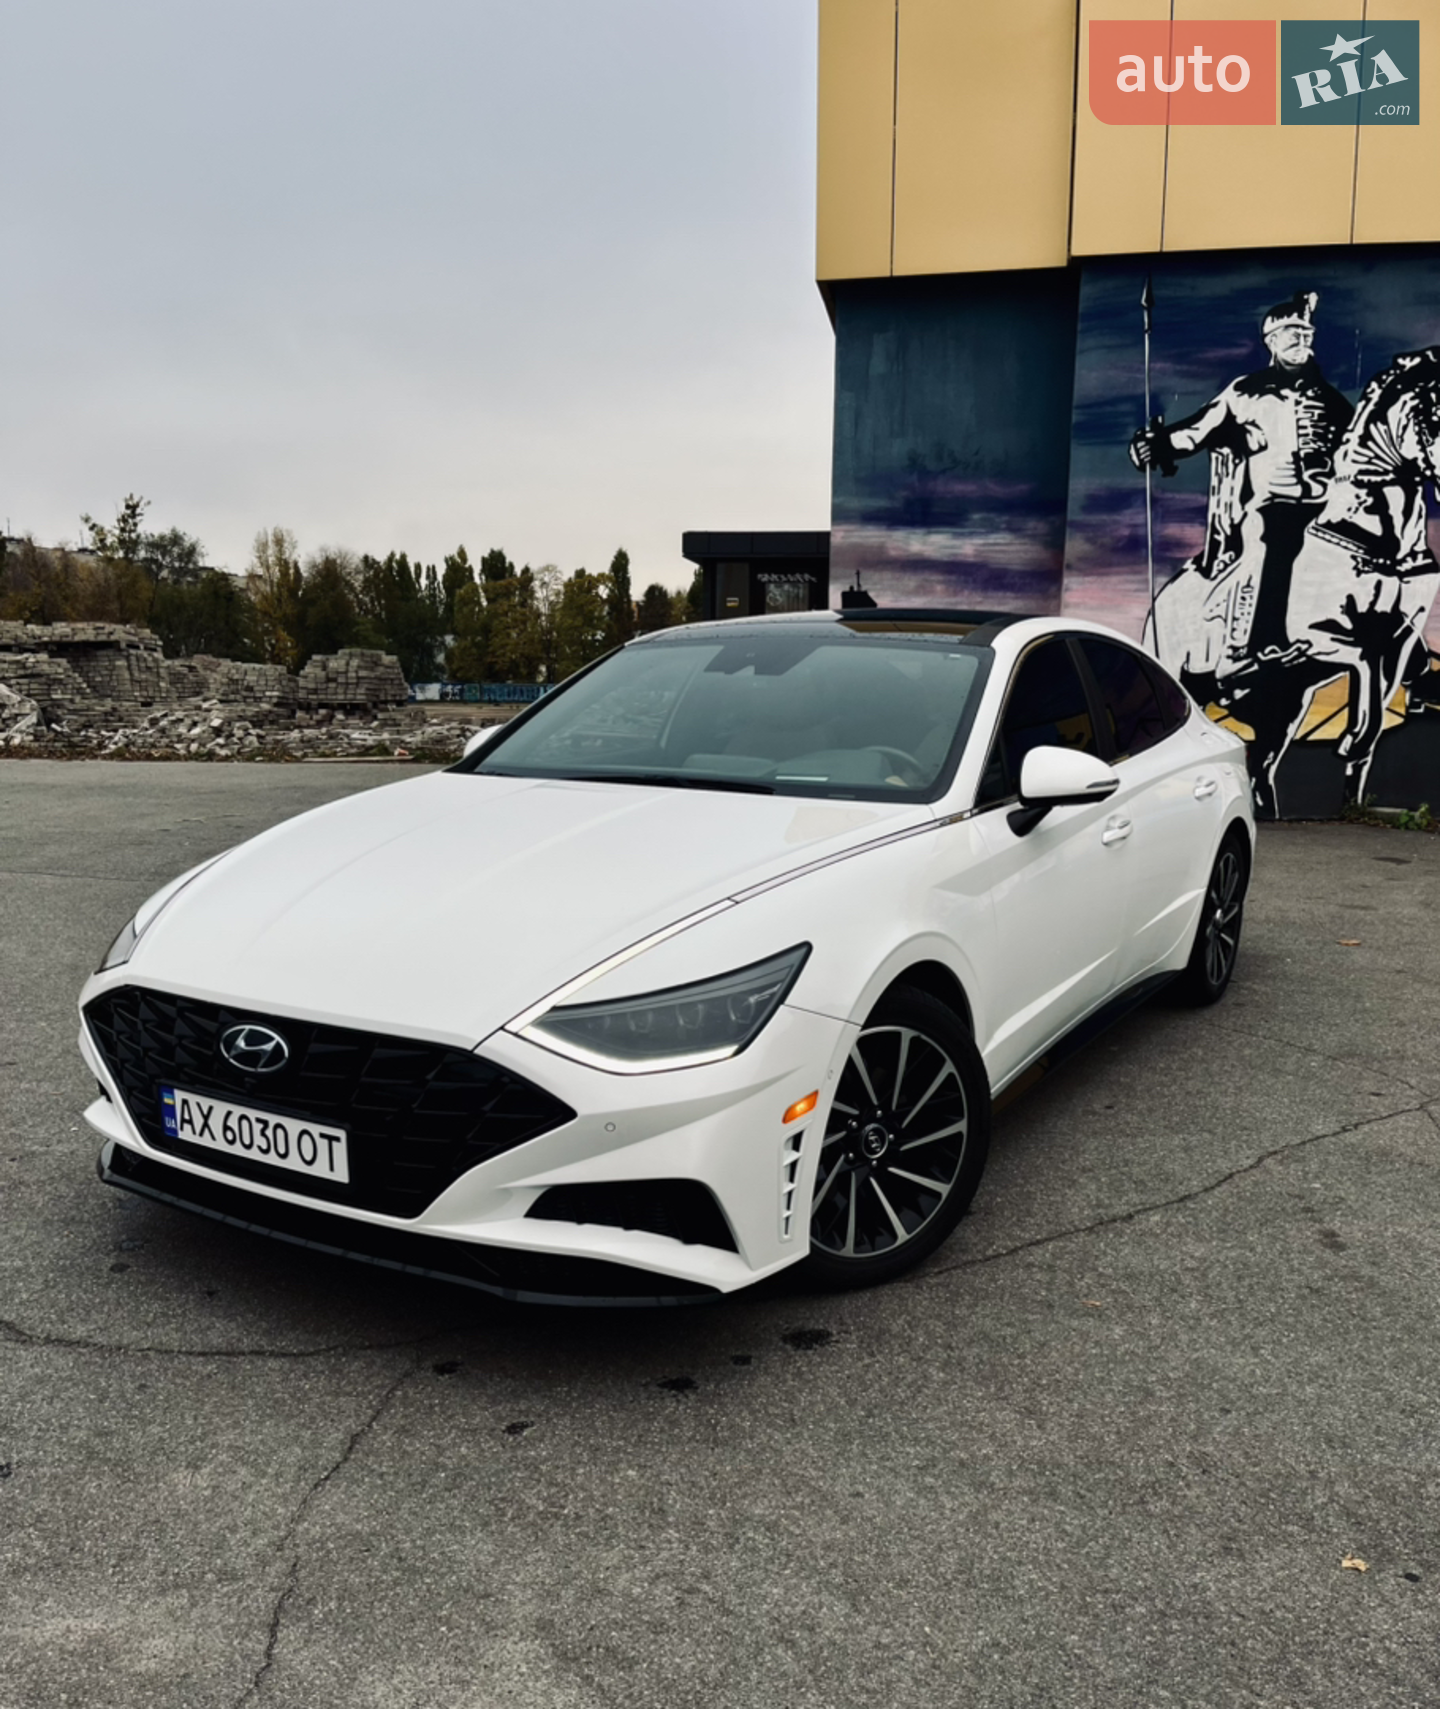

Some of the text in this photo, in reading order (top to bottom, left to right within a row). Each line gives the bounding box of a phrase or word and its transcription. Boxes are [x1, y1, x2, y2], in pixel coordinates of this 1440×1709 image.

[165, 1116, 177, 1129] UA
[179, 1098, 342, 1173] AX 6030 OT
